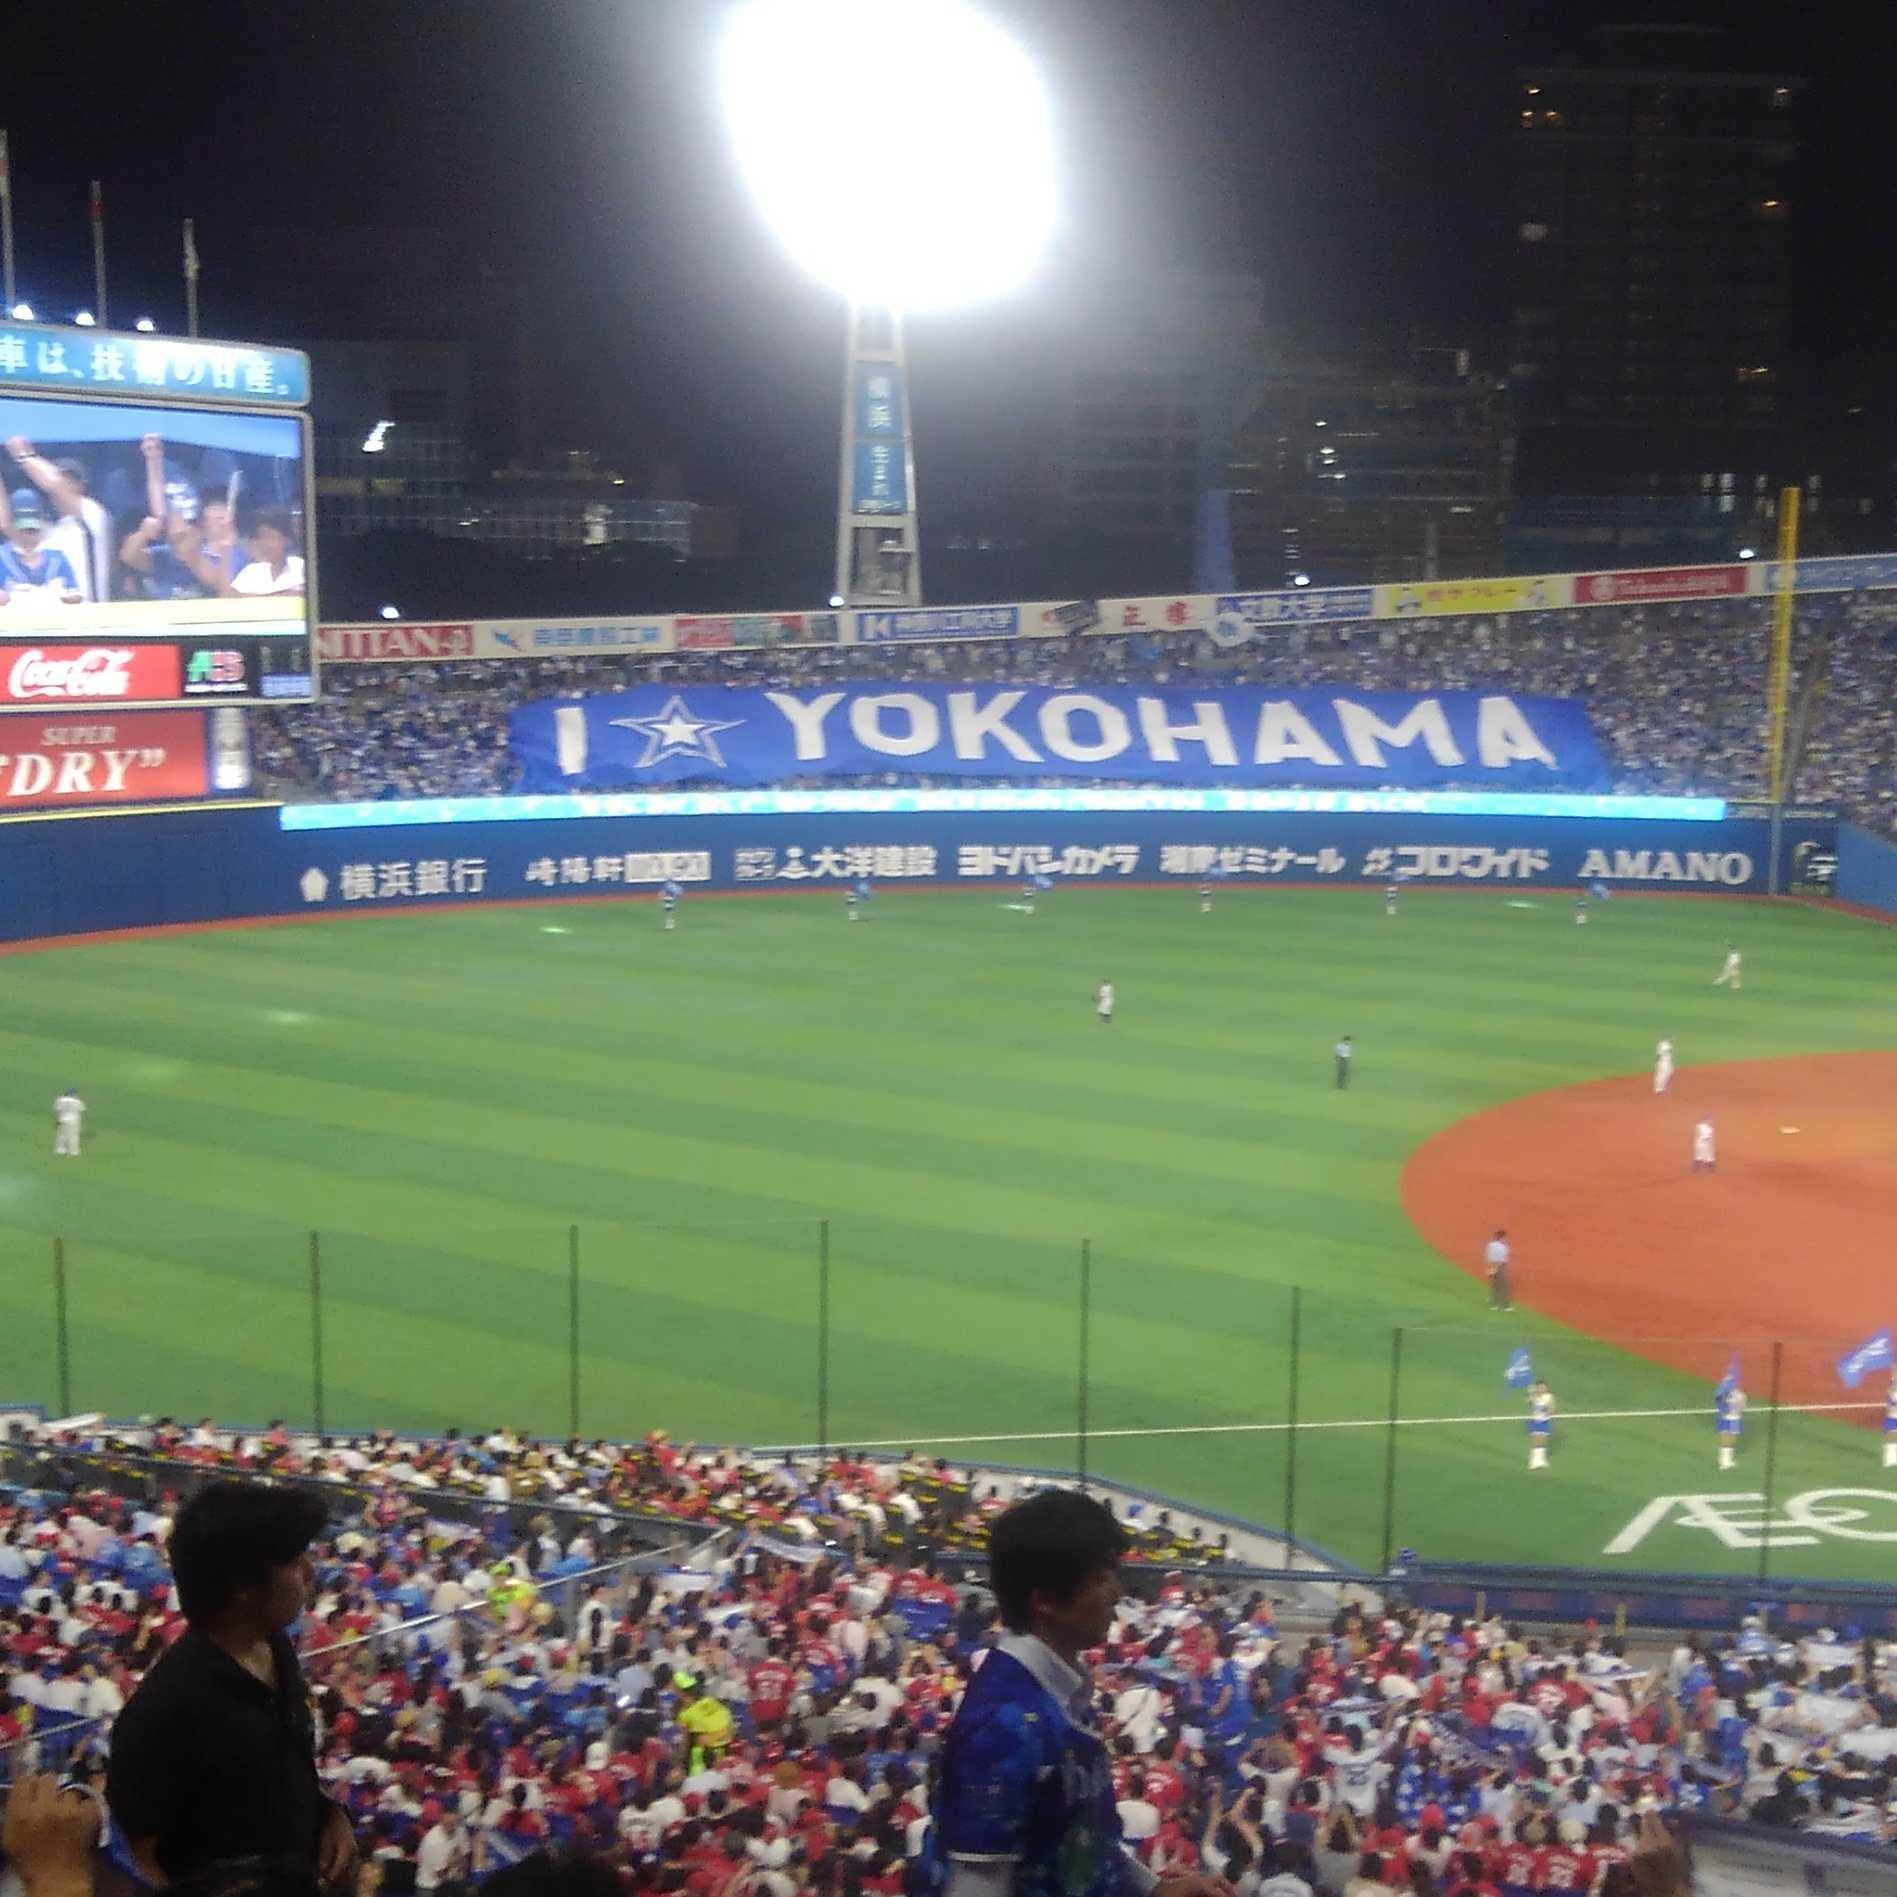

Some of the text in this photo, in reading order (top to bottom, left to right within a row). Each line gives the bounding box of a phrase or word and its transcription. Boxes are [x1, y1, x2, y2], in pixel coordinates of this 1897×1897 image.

[0, 334, 289, 395] 車は、技の日産。
[764, 691, 1560, 770] YOKOHAMA
[340, 858, 487, 900] 横浜銀行
[957, 844, 1141, 877] ヨドバシカメラ
[1397, 847, 1551, 878] コロワイド
[1577, 848, 1753, 885] AMANO
